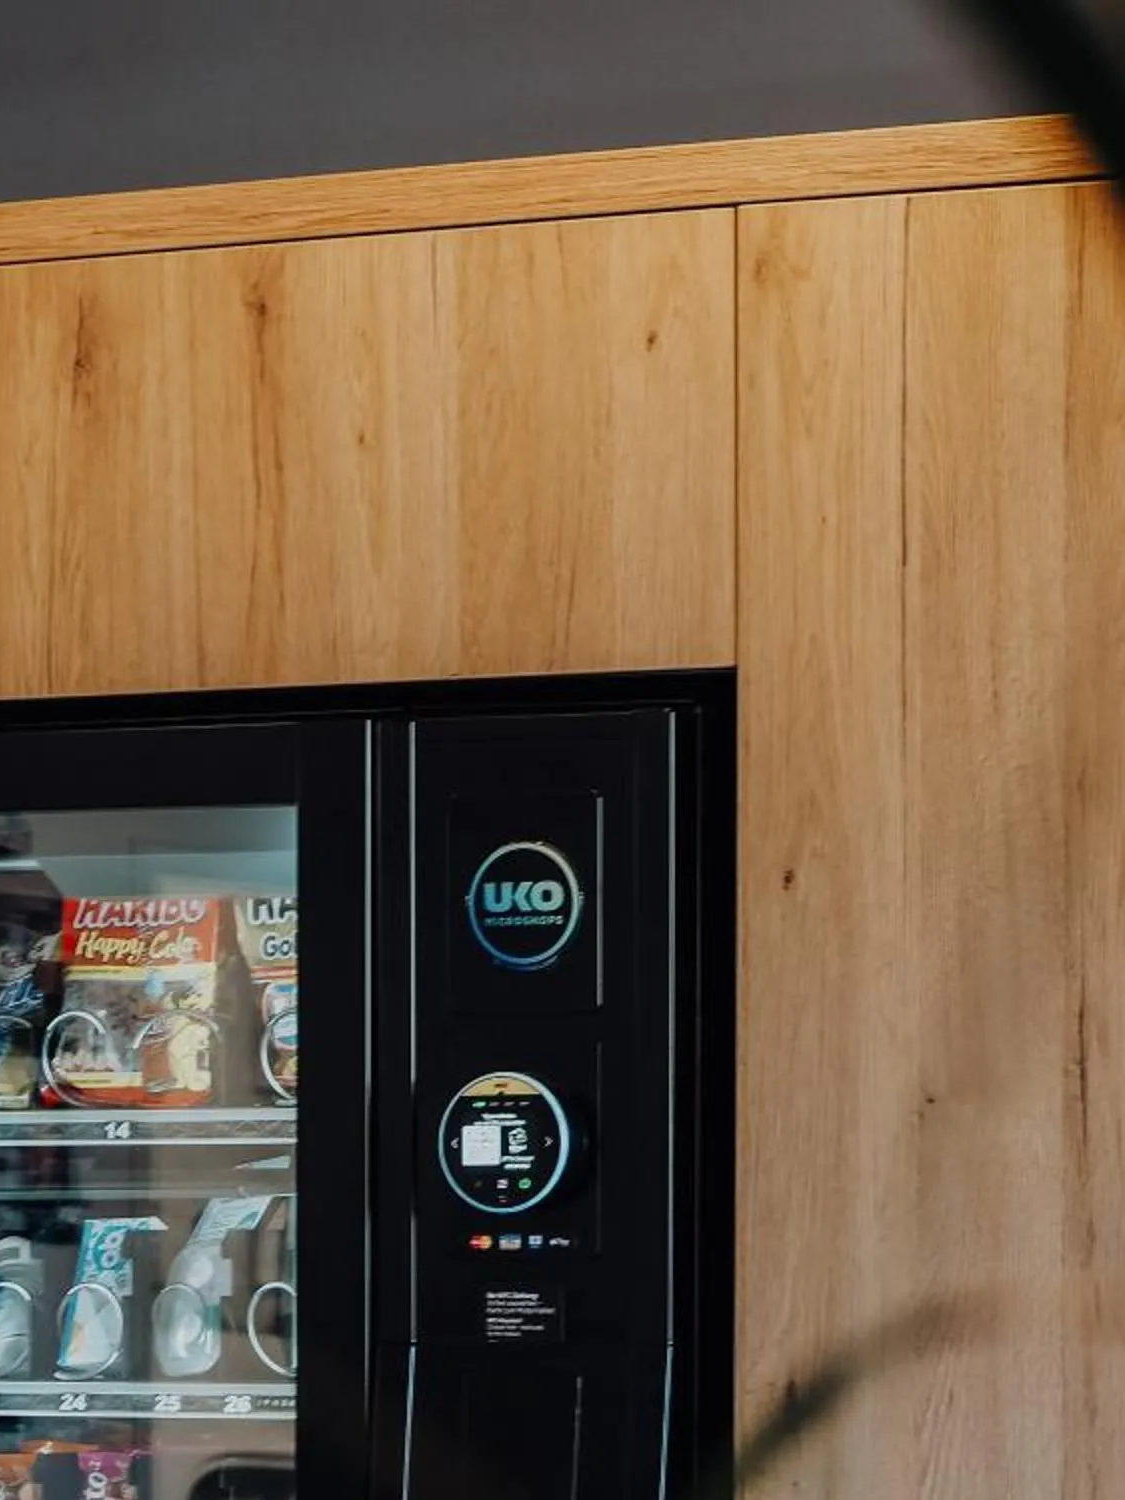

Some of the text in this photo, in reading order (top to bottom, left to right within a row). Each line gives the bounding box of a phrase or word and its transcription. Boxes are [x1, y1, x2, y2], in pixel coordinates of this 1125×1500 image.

[483, 880, 565, 912] UKO
[76, 930, 147, 963] Happy
[104, 1121, 131, 1139] 14
[59, 1393, 87, 1411] 24
[154, 1394, 181, 1412] 25
[224, 1395, 252, 1413] 26
